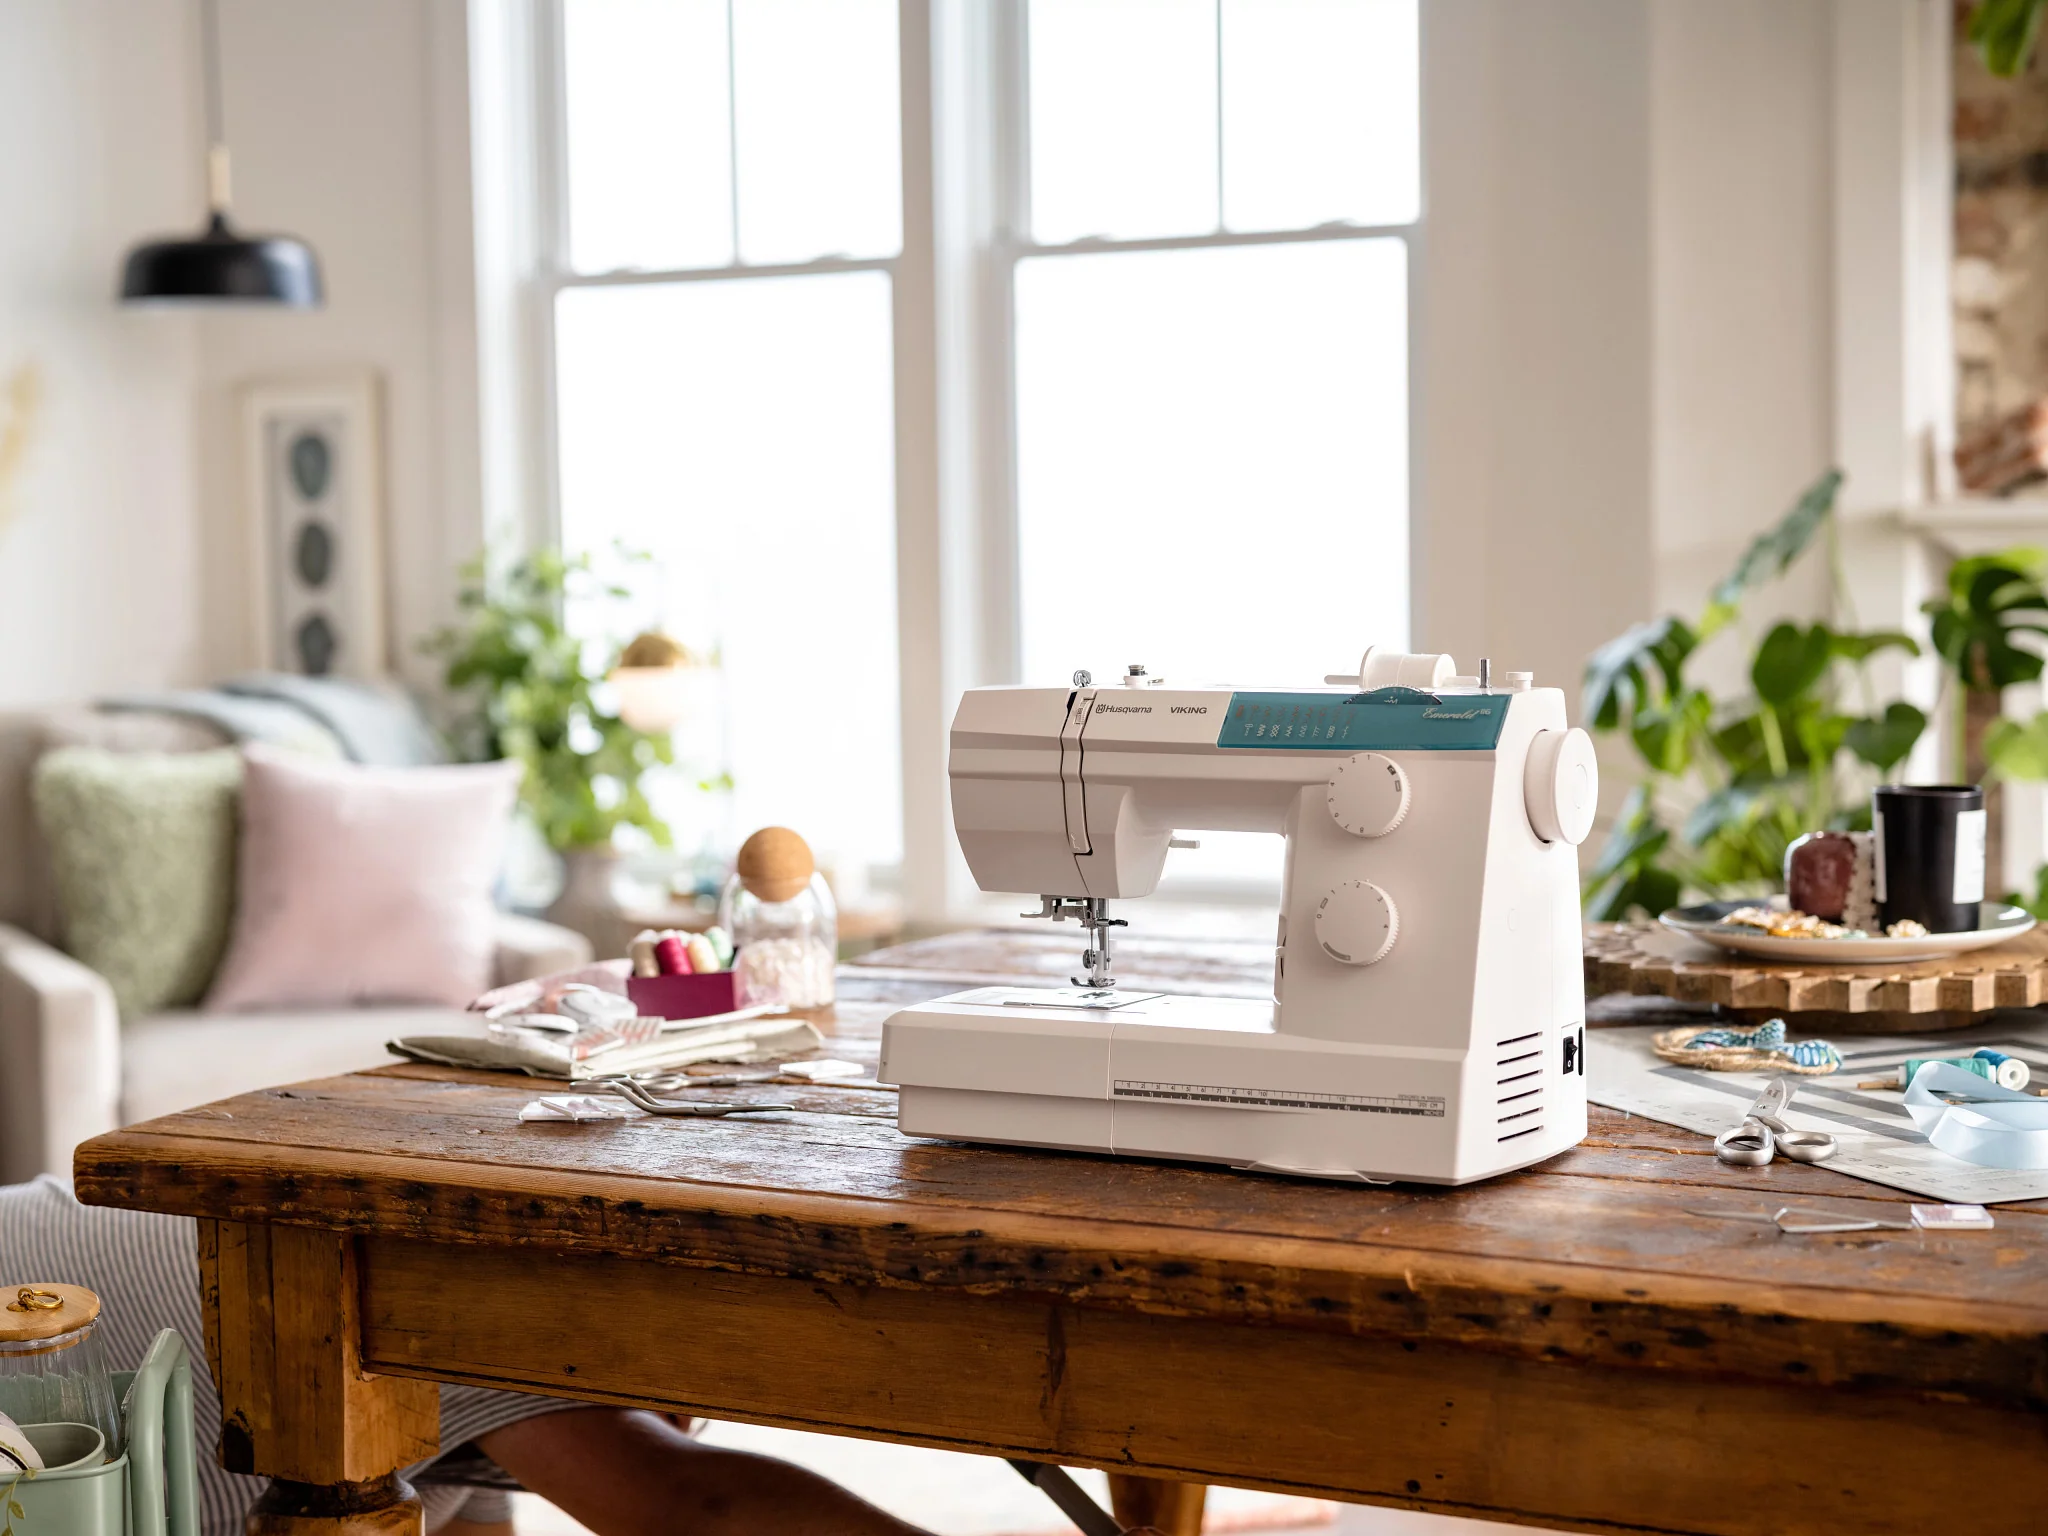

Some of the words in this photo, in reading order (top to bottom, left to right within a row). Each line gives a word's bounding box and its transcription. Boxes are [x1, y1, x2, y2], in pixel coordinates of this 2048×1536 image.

[1105, 704, 1152, 714] Husqvarna
[1170, 706, 1207, 714] VIKING
[1422, 707, 1480, 720] Emerald
